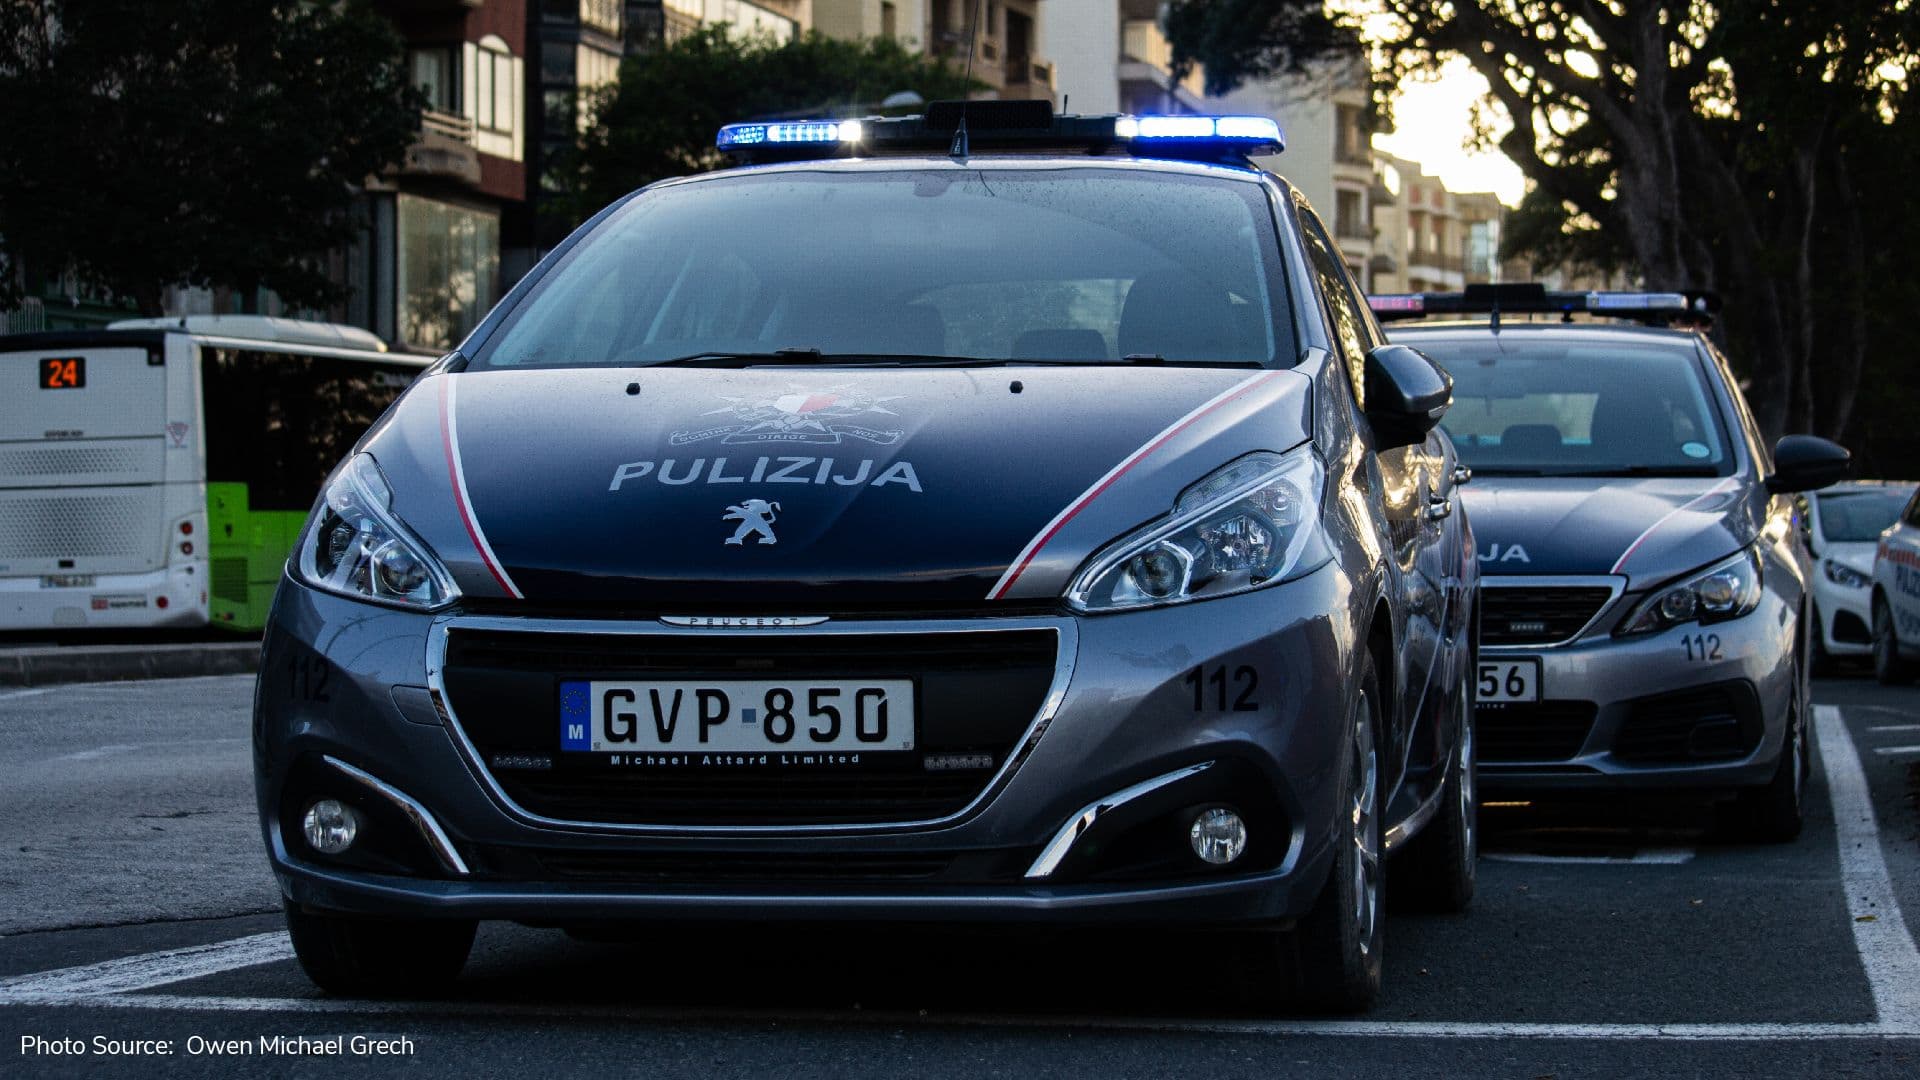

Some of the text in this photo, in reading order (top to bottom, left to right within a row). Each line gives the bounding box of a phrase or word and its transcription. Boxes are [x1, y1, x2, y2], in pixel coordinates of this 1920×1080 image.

[49, 359, 77, 387] 24
[609, 457, 923, 492] PULIZIJA
[1478, 543, 1530, 562] JA
[690, 617, 799, 625] PEUGEOT
[1681, 634, 1722, 661] 112
[288, 656, 330, 703] 112
[1185, 664, 1259, 712] 112
[1479, 665, 1525, 698] 56
[603, 687, 889, 744] GVP 850
[568, 724, 583, 740] M
[610, 754, 860, 766] Michael Attard Limited
